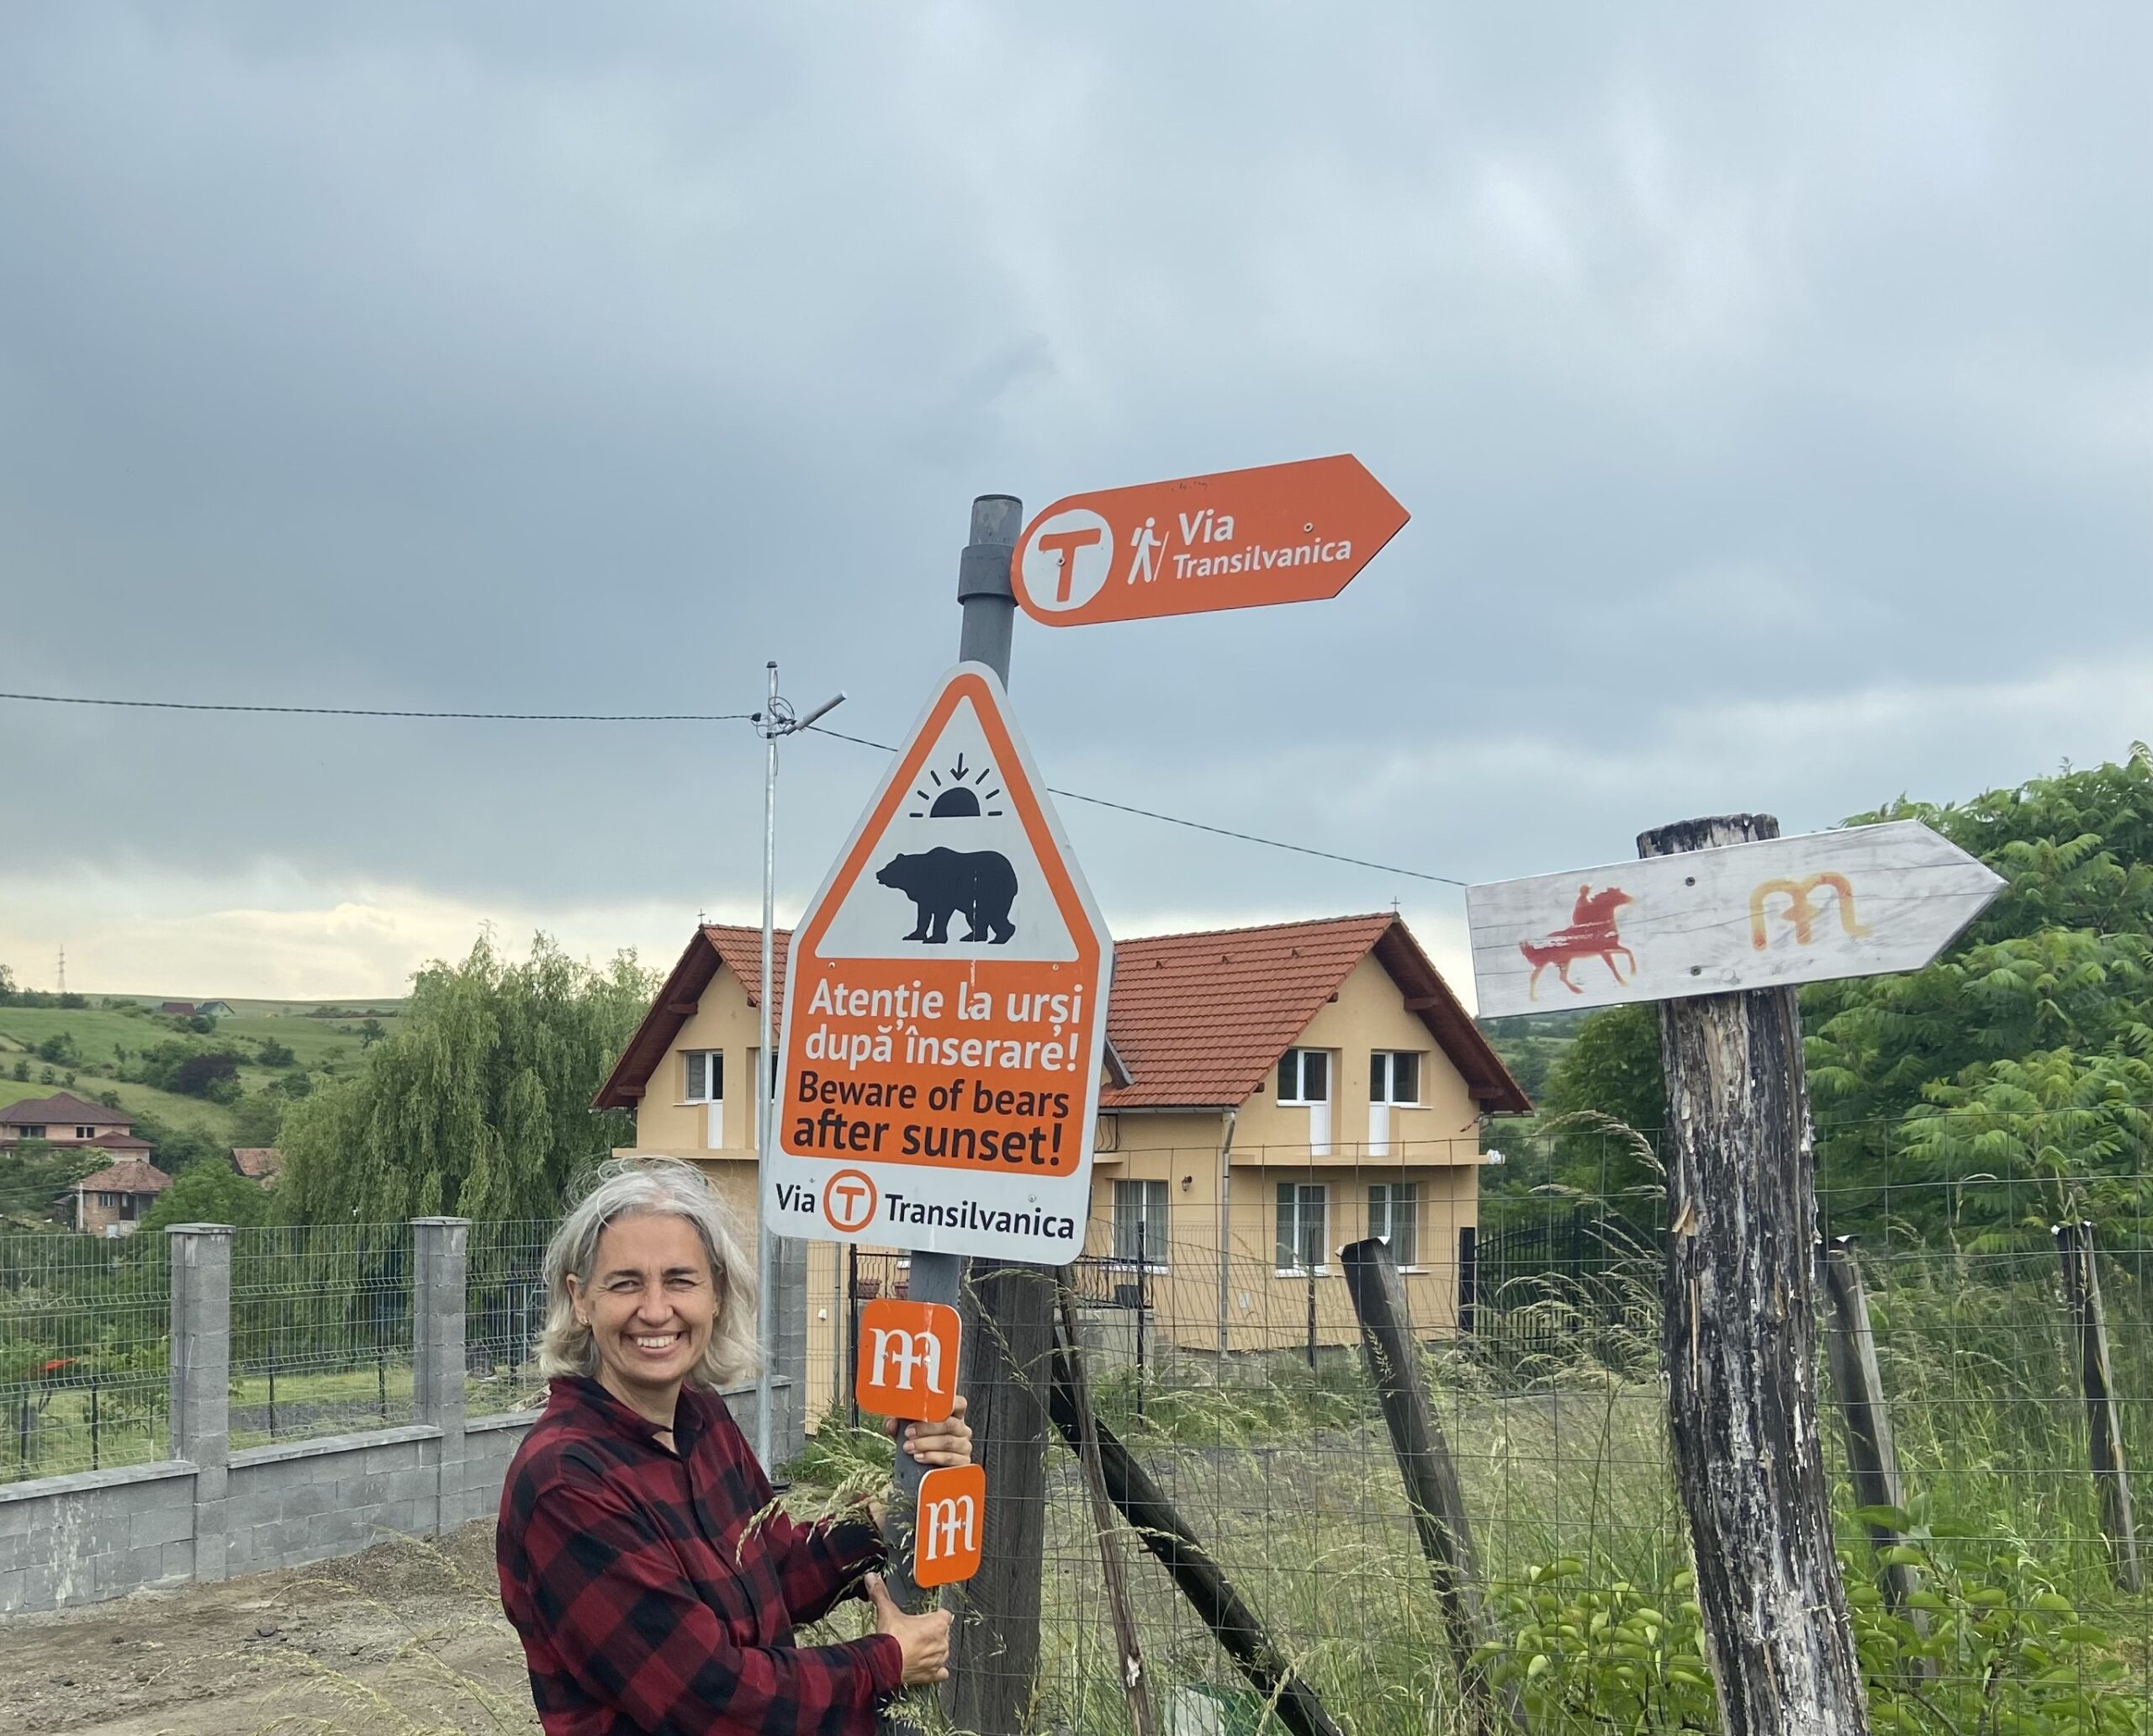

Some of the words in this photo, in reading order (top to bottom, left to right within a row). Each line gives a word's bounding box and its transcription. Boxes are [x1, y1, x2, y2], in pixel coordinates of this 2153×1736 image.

[1178, 508, 1235, 545] Via
[1038, 527, 1102, 602] T
[1172, 541, 1351, 580] Transilvanica
[808, 977, 944, 1031] Atenție
[957, 981, 992, 1021] la
[1007, 984, 1082, 1037] urși
[805, 1024, 892, 1071] după
[905, 1025, 1078, 1072] înserare!
[799, 1071, 917, 1109] Beware
[928, 1079, 965, 1111] of
[973, 1081, 1069, 1118] bears
[793, 1109, 890, 1152] after
[902, 1123, 1062, 1166] sunset!
[775, 1183, 815, 1214] Via
[836, 1186, 865, 1221] T
[885, 1194, 1074, 1240] Transilvanica
